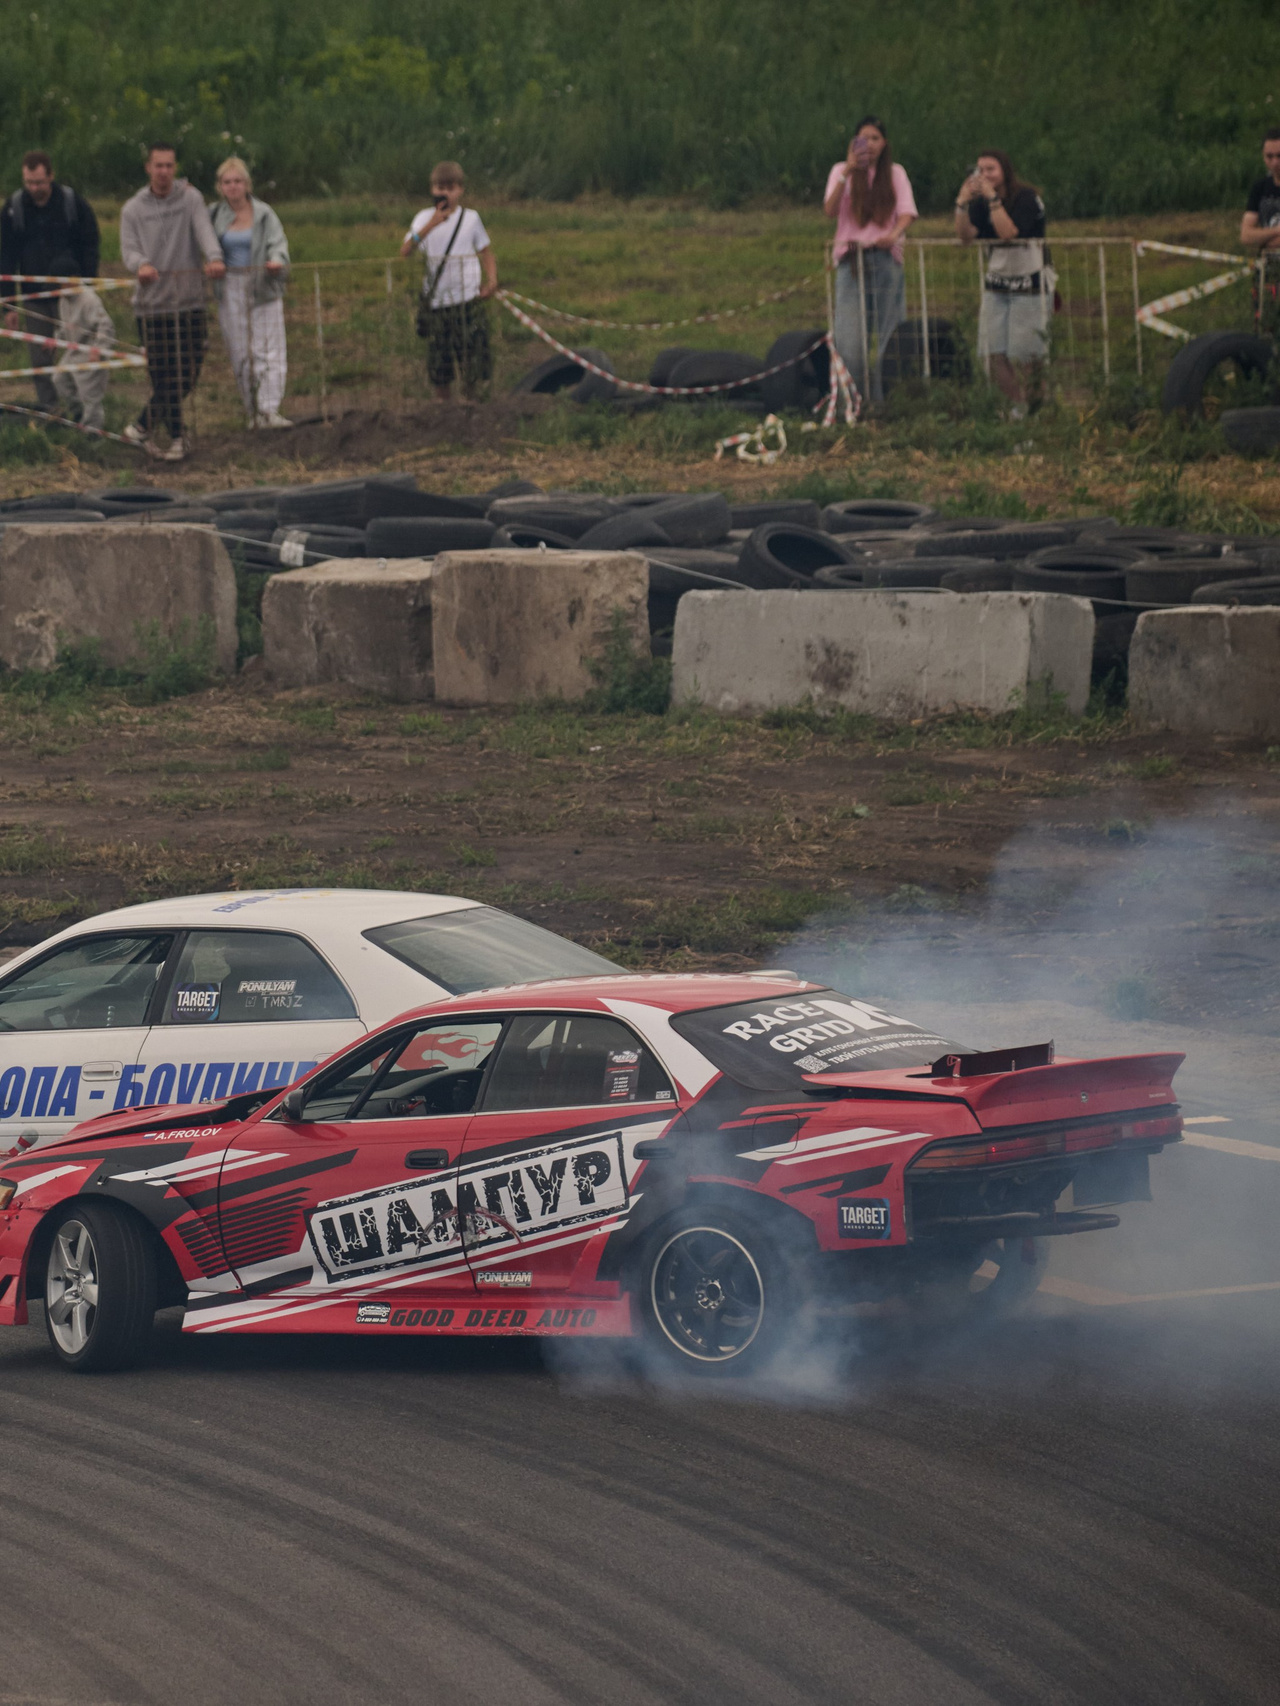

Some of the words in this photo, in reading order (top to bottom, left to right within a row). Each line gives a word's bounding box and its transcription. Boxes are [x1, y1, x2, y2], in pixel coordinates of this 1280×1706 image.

[239, 980, 296, 993] PONULYAM
[177, 991, 219, 1007] TARGET
[722, 1002, 824, 1041] RACE
[769, 1019, 855, 1053] GRID
[154, 1128, 222, 1140] A.FROLOV
[319, 1150, 612, 1267] ШАМПУР
[841, 1207, 887, 1224] TARGET
[477, 1272, 532, 1283] PONULYAM
